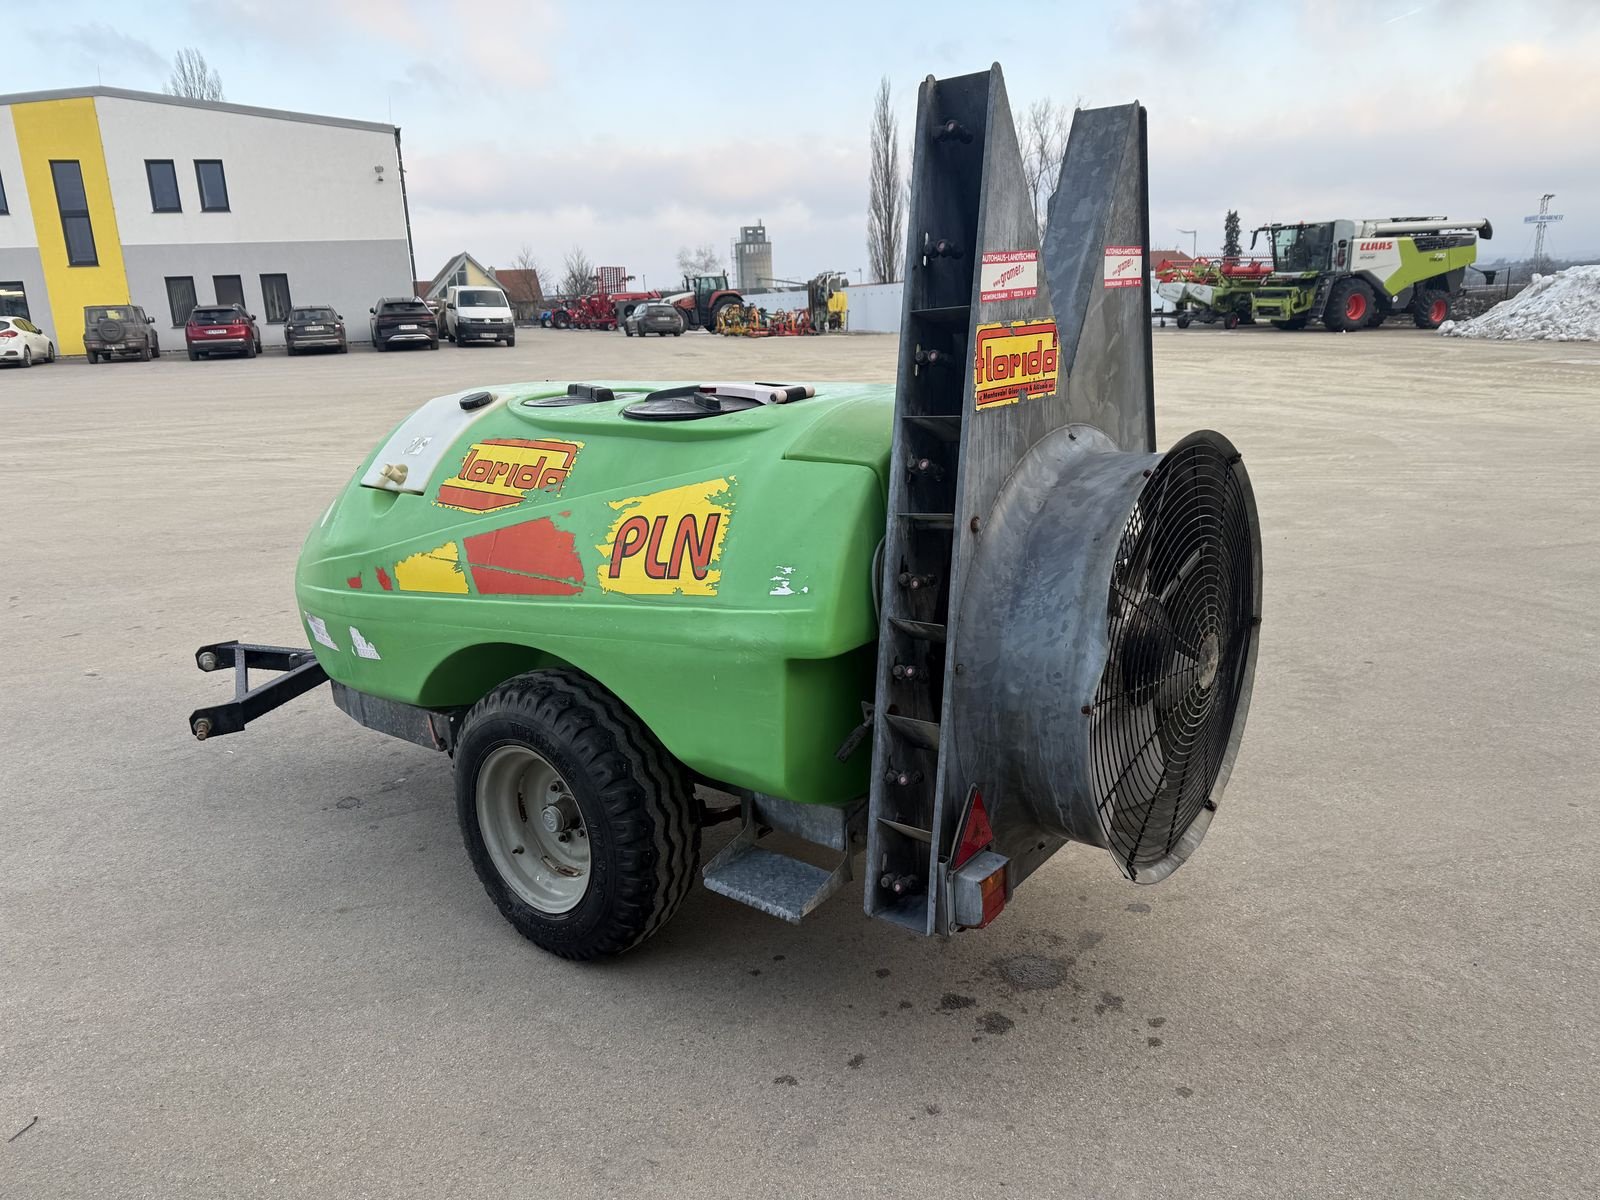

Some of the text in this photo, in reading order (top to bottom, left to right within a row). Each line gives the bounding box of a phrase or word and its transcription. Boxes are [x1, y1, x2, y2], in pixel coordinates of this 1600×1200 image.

[1360, 241, 1393, 250] CLAAS
[458, 449, 568, 493] lorida
[607, 512, 722, 581] PLN
